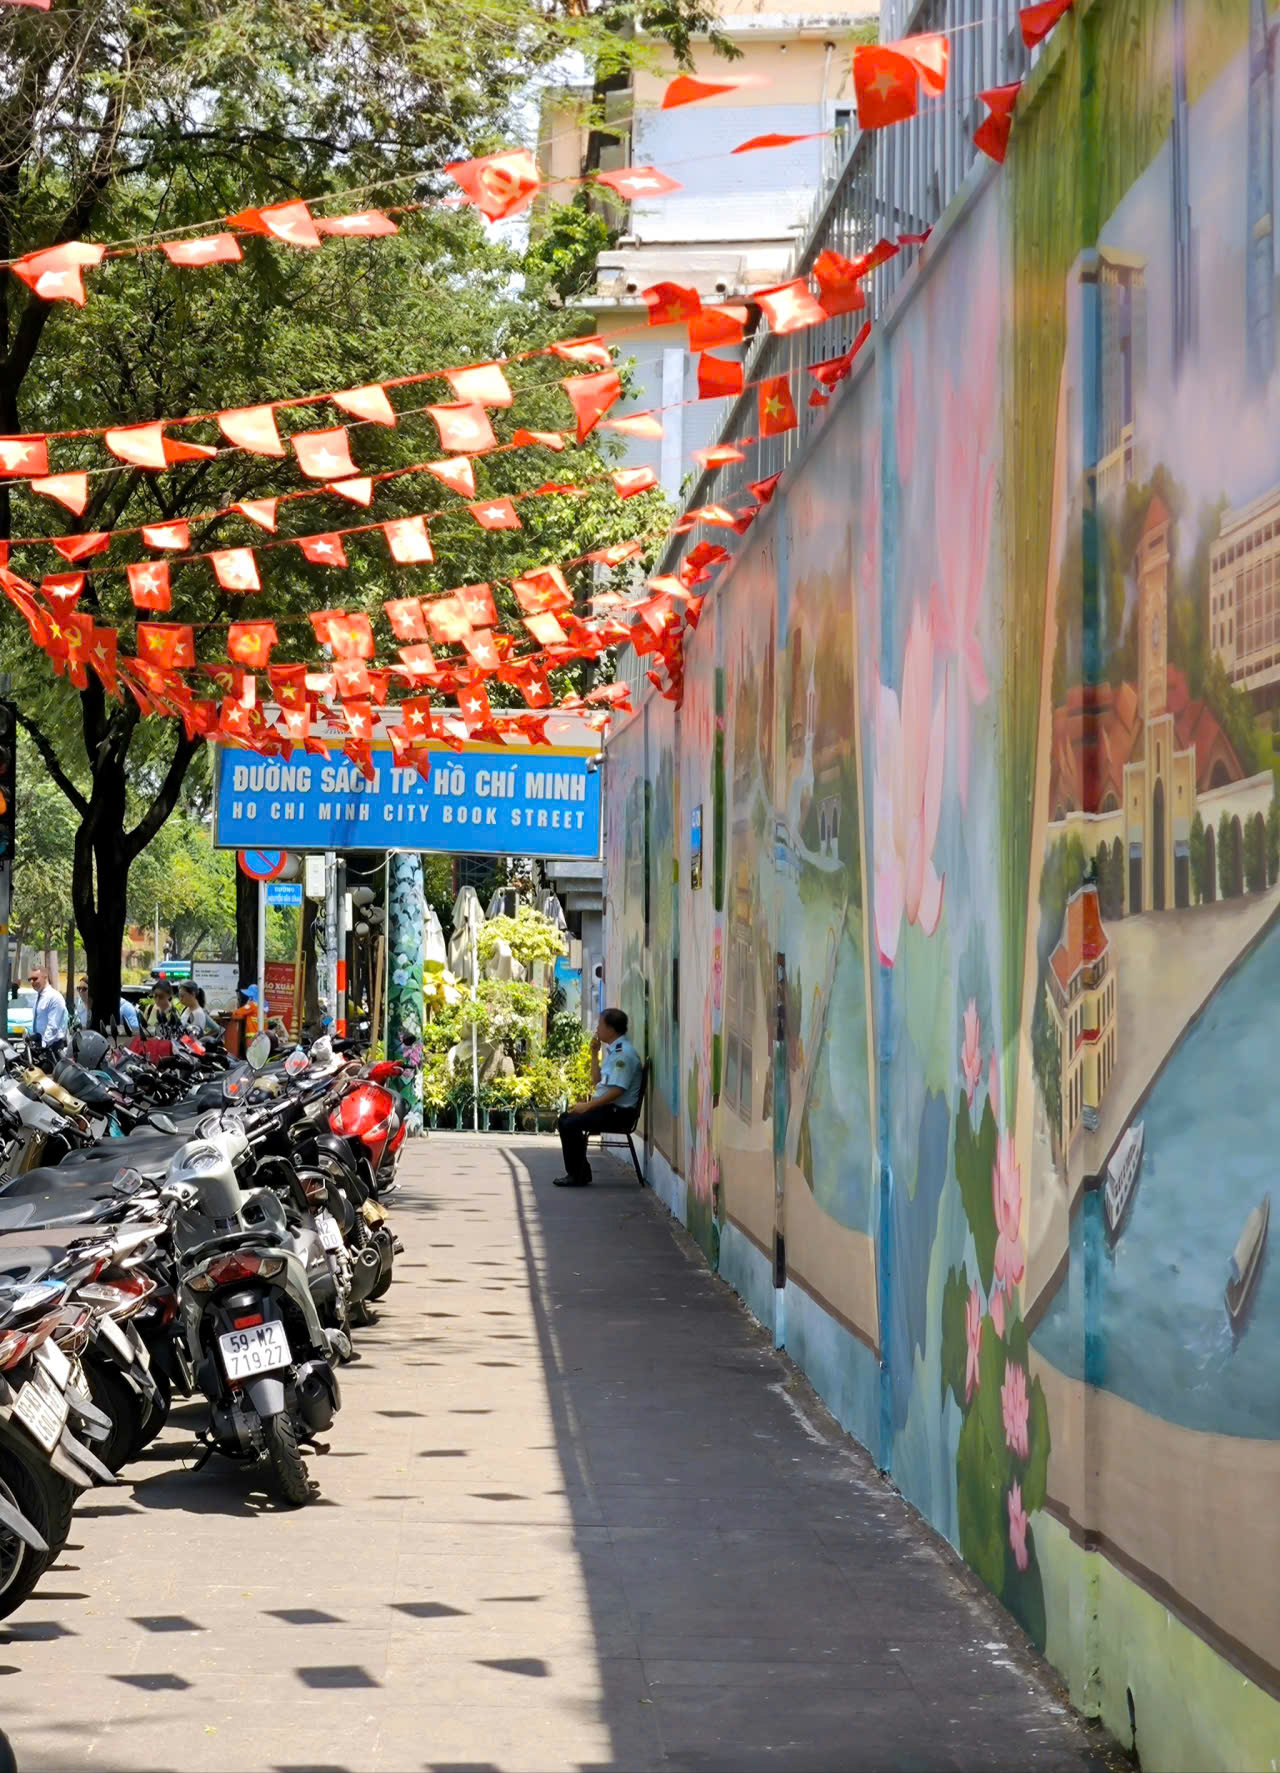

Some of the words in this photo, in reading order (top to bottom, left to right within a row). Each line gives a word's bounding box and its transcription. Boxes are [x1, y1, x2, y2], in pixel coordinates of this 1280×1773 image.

[233, 758, 312, 793] ĐƯỜNG
[320, 759, 381, 794] SÁCH
[389, 767, 424, 796] TP.
[433, 760, 466, 797] HỒ
[475, 763, 518, 799] CHÍ
[524, 771, 586, 801] MINH
[232, 801, 257, 820] HO
[271, 802, 305, 820] CHI
[318, 802, 370, 822] MINH
[383, 803, 430, 823] CITY
[442, 805, 497, 826] BOOK
[510, 808, 585, 830] STREET
[230, 1327, 276, 1353] 59-M2
[231, 1346, 282, 1375] 719.27
